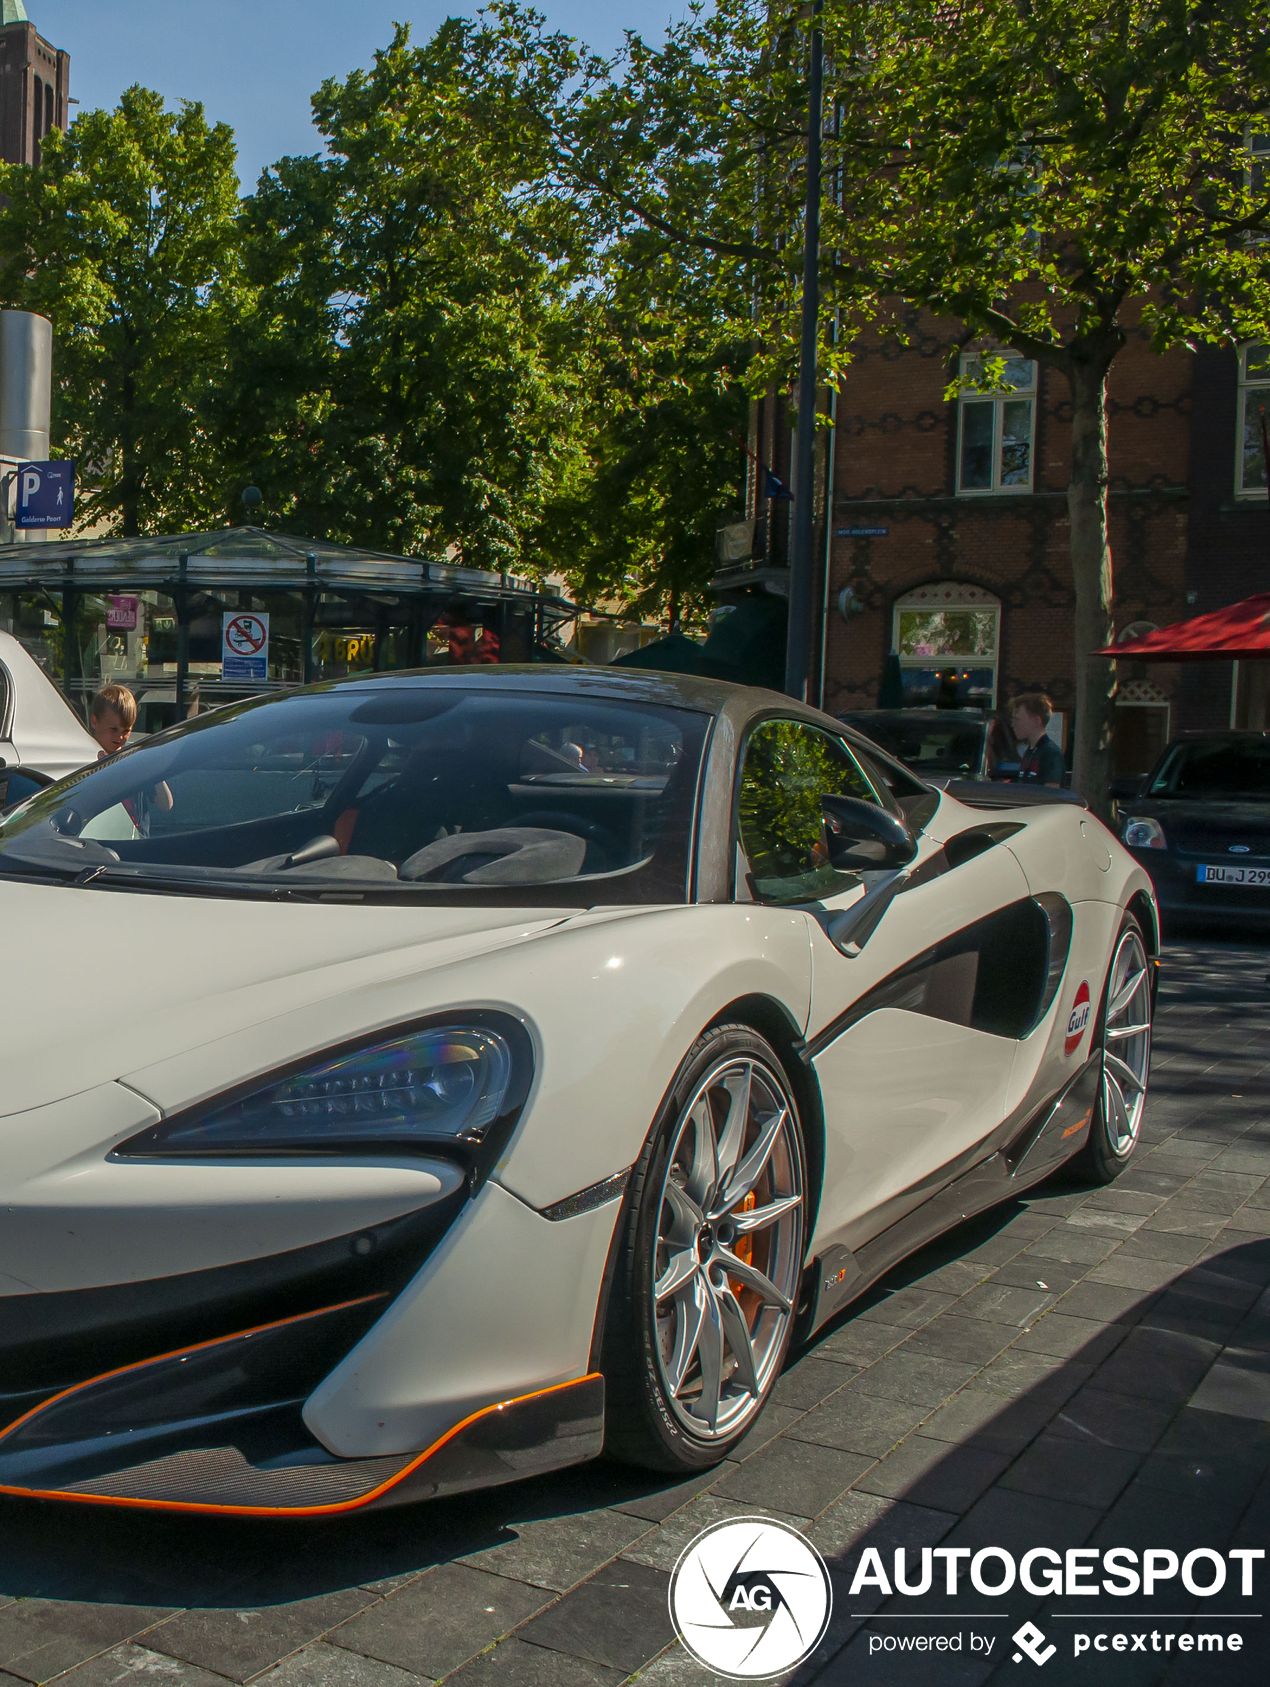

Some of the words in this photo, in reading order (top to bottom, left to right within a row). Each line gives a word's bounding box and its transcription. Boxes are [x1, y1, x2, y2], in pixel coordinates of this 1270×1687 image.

[22, 472, 41, 508] P
[1207, 868, 1225, 881] DU
[1235, 870, 1245, 882] J
[1067, 1006, 1090, 1033] Gulf
